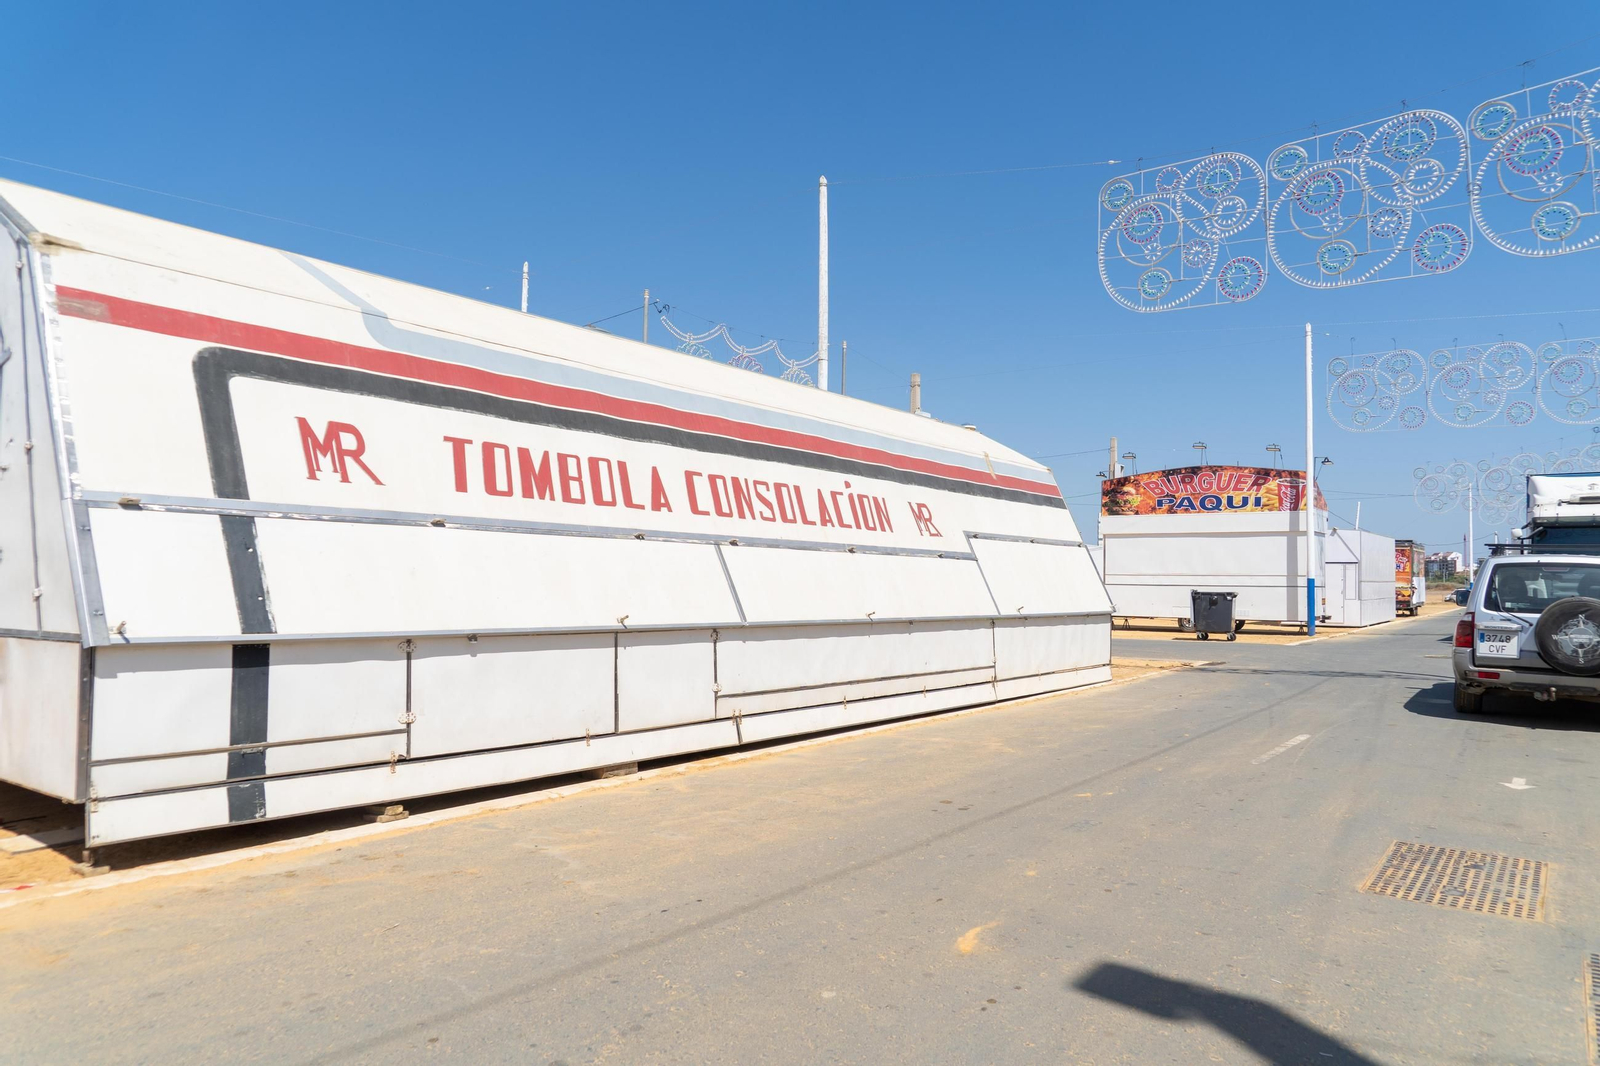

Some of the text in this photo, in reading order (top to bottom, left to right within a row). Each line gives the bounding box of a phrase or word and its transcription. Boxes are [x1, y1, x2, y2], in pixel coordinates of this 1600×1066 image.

[443, 436, 673, 513] TOMBOLA
[1142, 472, 1272, 497] BURGUER
[1155, 494, 1262, 511] PAQUI
[1485, 634, 1511, 643] 3748
[1488, 644, 1507, 654] CVF
